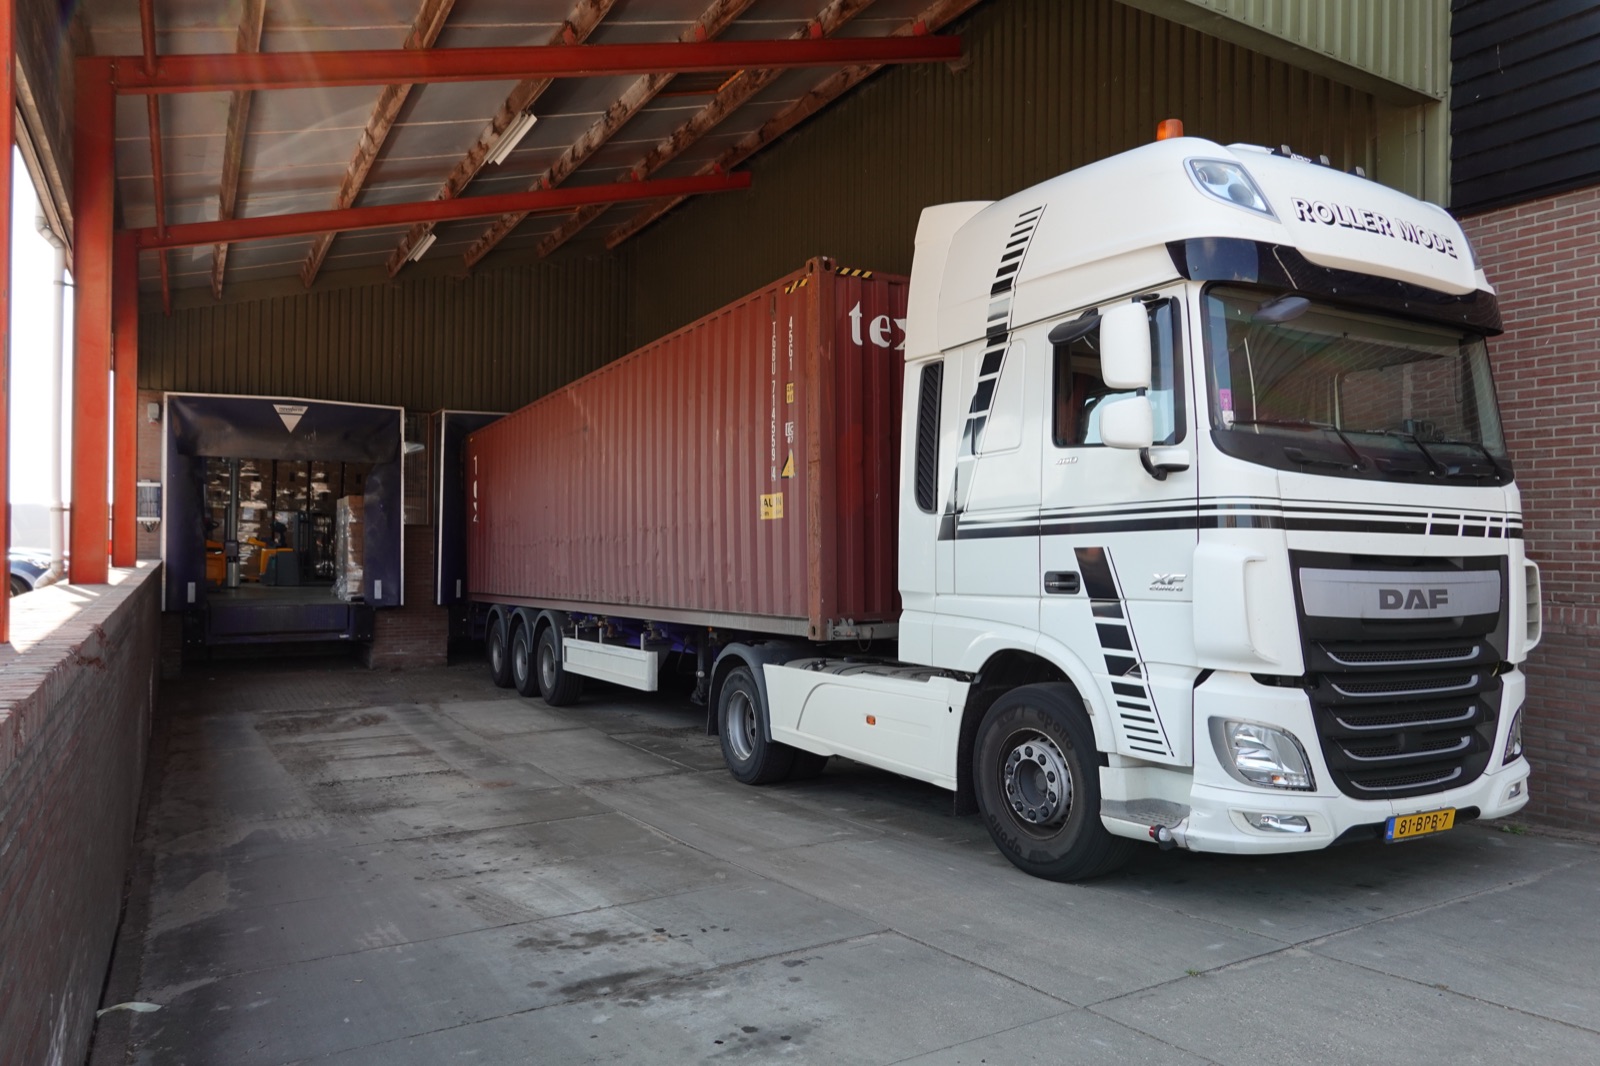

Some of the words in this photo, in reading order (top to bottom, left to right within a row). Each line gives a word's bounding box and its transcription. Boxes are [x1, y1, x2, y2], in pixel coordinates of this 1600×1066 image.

[1291, 197, 1395, 238] ROLLER
[1395, 218, 1458, 260] MODE
[1151, 573, 1187, 585] XF
[1379, 589, 1448, 610] DAF
[1036, 708, 1075, 750] apollo
[989, 813, 1023, 855] apollo
[1399, 812, 1449, 835] 81-BPB-7
